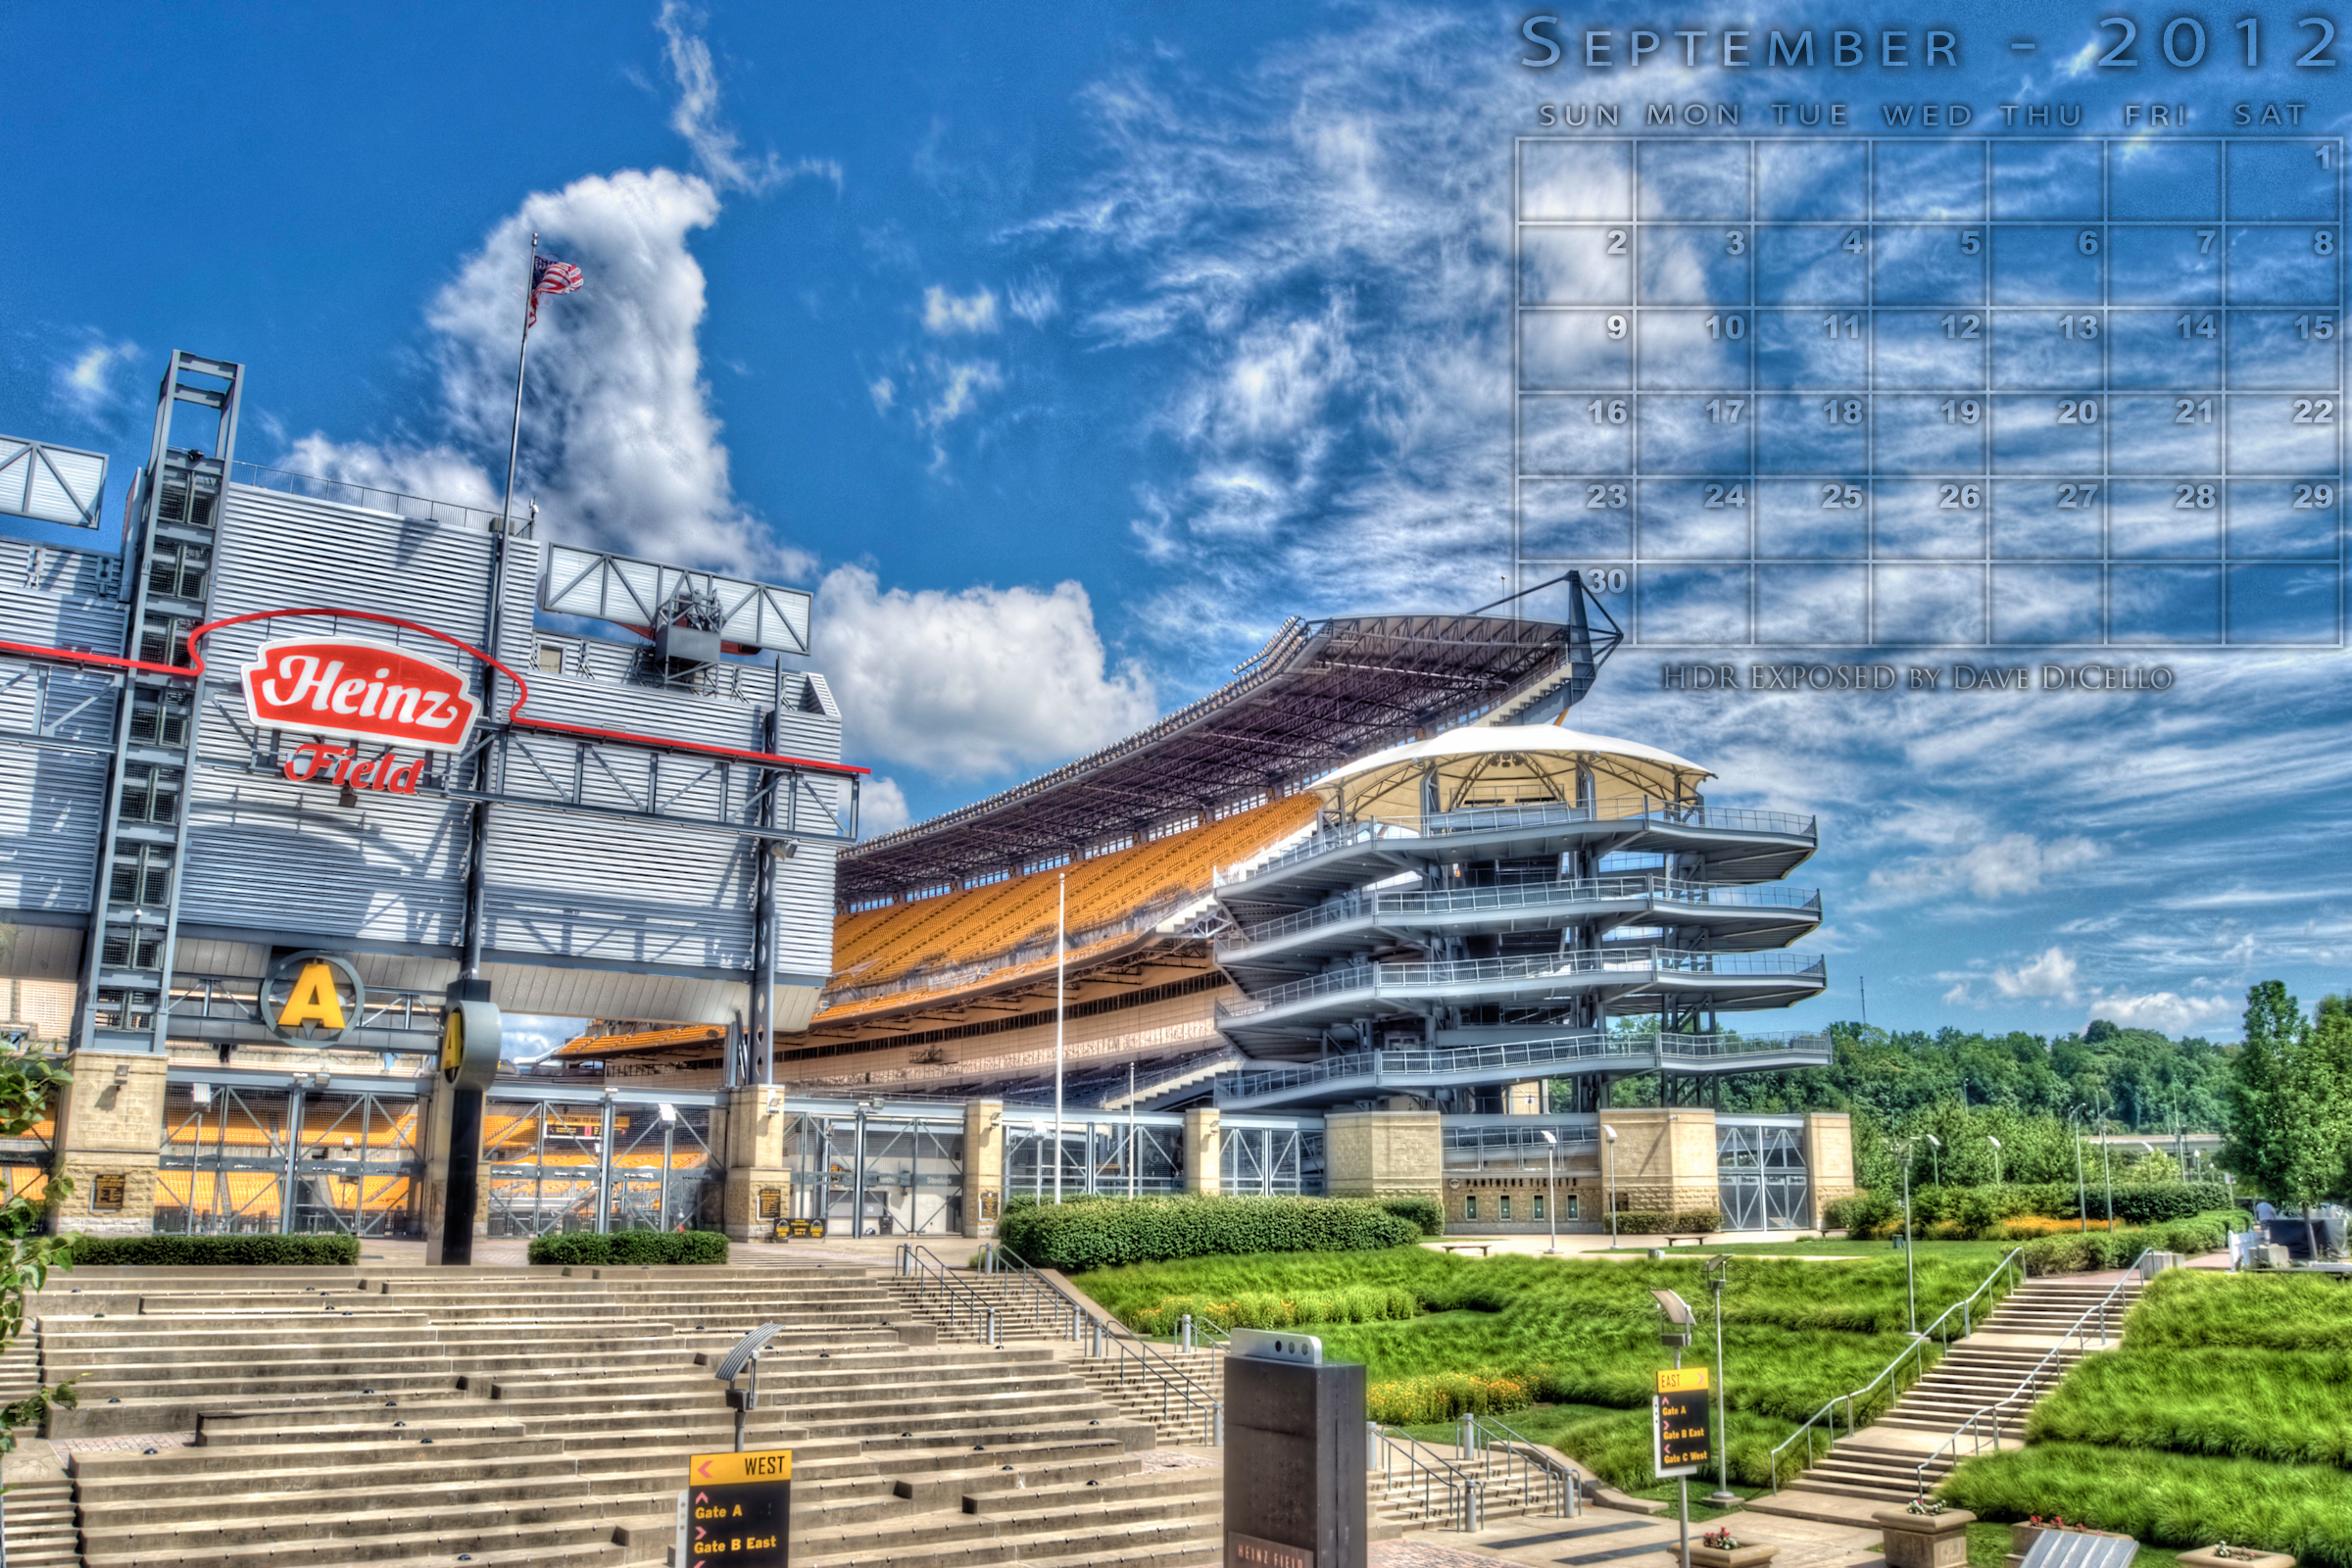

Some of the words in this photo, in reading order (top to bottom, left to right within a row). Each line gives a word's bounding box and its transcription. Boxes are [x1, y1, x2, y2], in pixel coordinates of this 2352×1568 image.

[262, 655, 459, 728] Heinz
[283, 743, 425, 795] Field
[277, 963, 347, 1029] A
[442, 1011, 462, 1069] A
[1466, 1178, 1523, 1187] PANTHERS
[1530, 1178, 1577, 1187] TICETS
[1661, 1374, 1680, 1388] EAST
[1662, 1406, 1679, 1416] Gate
[1681, 1405, 1687, 1414] A
[1663, 1430, 1680, 1440] Gate
[1682, 1429, 1688, 1439] B
[1689, 1428, 1704, 1438] East
[745, 1455, 785, 1476] WEST
[1664, 1454, 1681, 1464] Gate
[1682, 1452, 1689, 1462] C
[1690, 1450, 1707, 1460] West
[695, 1505, 726, 1519] Gate
[732, 1504, 743, 1517] A
[694, 1541, 726, 1554] Gate
[731, 1539, 742, 1551] B
[746, 1536, 776, 1549] East
[1238, 1544, 1268, 1565] HEINZ
